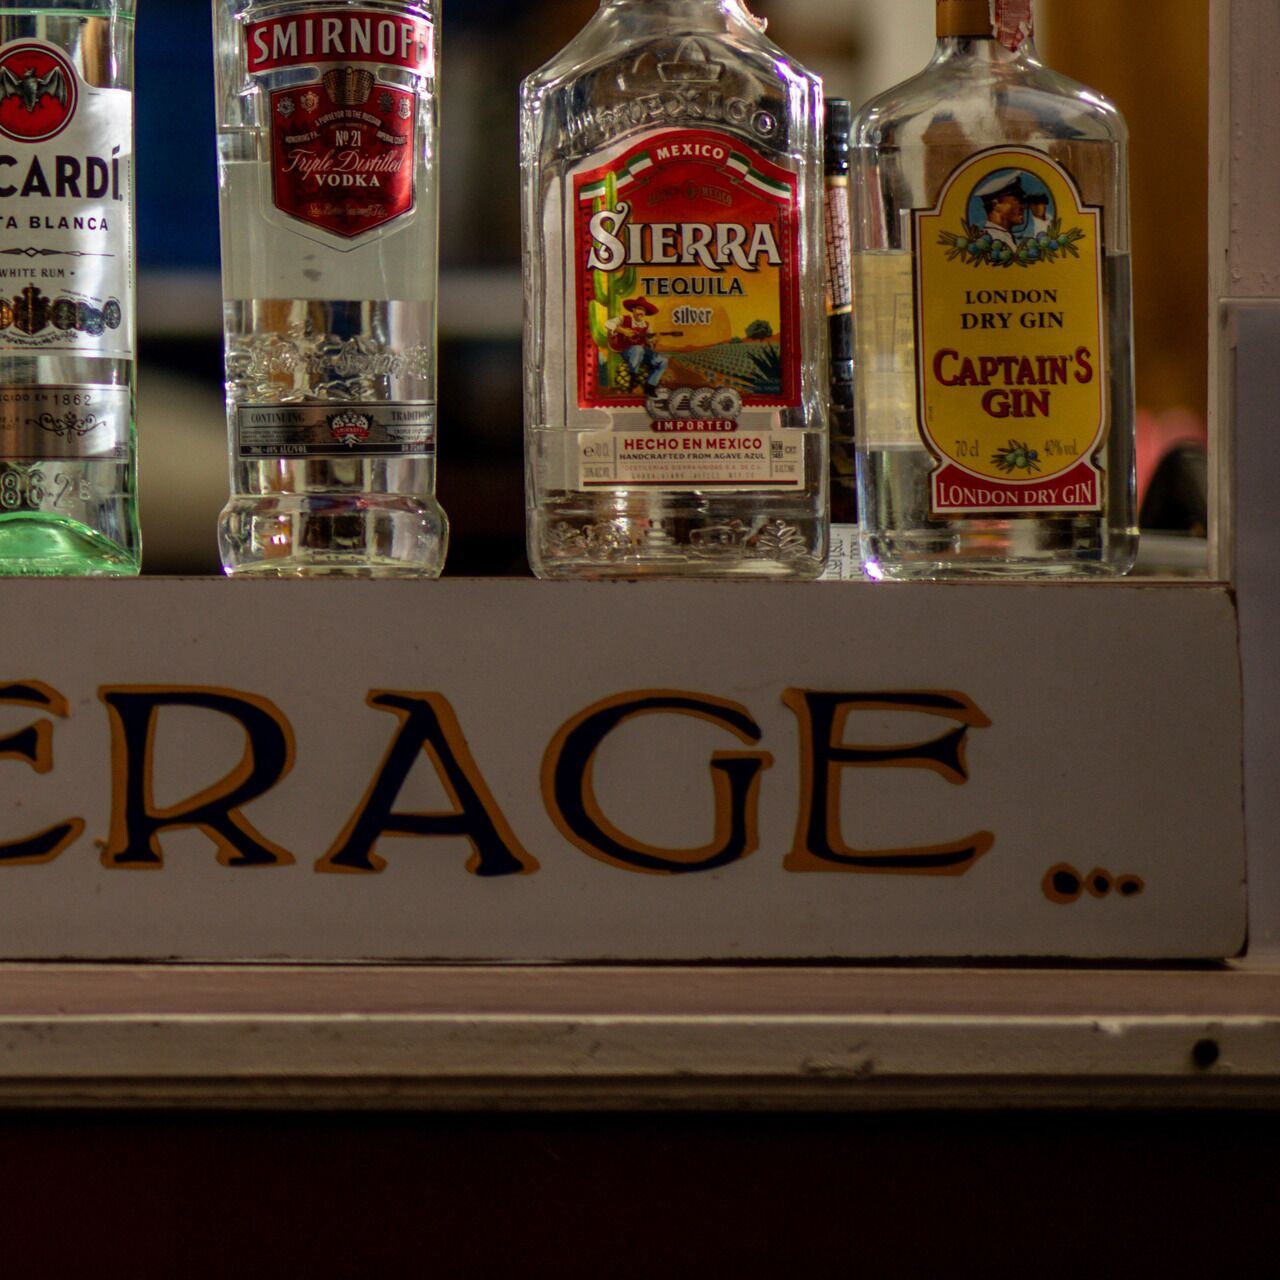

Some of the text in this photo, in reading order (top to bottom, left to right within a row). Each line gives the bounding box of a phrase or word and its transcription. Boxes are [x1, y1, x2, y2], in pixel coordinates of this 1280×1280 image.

[351, 129, 362, 147] 21
[656, 143, 725, 161] MEXICO
[281, 148, 405, 181] Triple Distilled
[315, 173, 381, 188] VODKA
[29, 216, 109, 232] BLANCA
[586, 200, 783, 272] SIERRA
[41, 268, 65, 278] RUM
[641, 277, 744, 296] TEQUILA
[965, 288, 1058, 305] LONDON
[671, 305, 713, 326] silver
[960, 311, 1065, 330] DRY GIN
[933, 346, 1094, 387] CAPTAIN'S
[52, 393, 92, 407] 1862
[981, 388, 1051, 418] GIN
[657, 421, 733, 431] IMPORTED
[623, 438, 763, 450] HECHO EN MEXICO
[954, 439, 968, 458] 70
[619, 452, 765, 461] HANDCRAFTED FROM AGAVE AZUL
[940, 479, 1093, 506] LONDON DRY GIN
